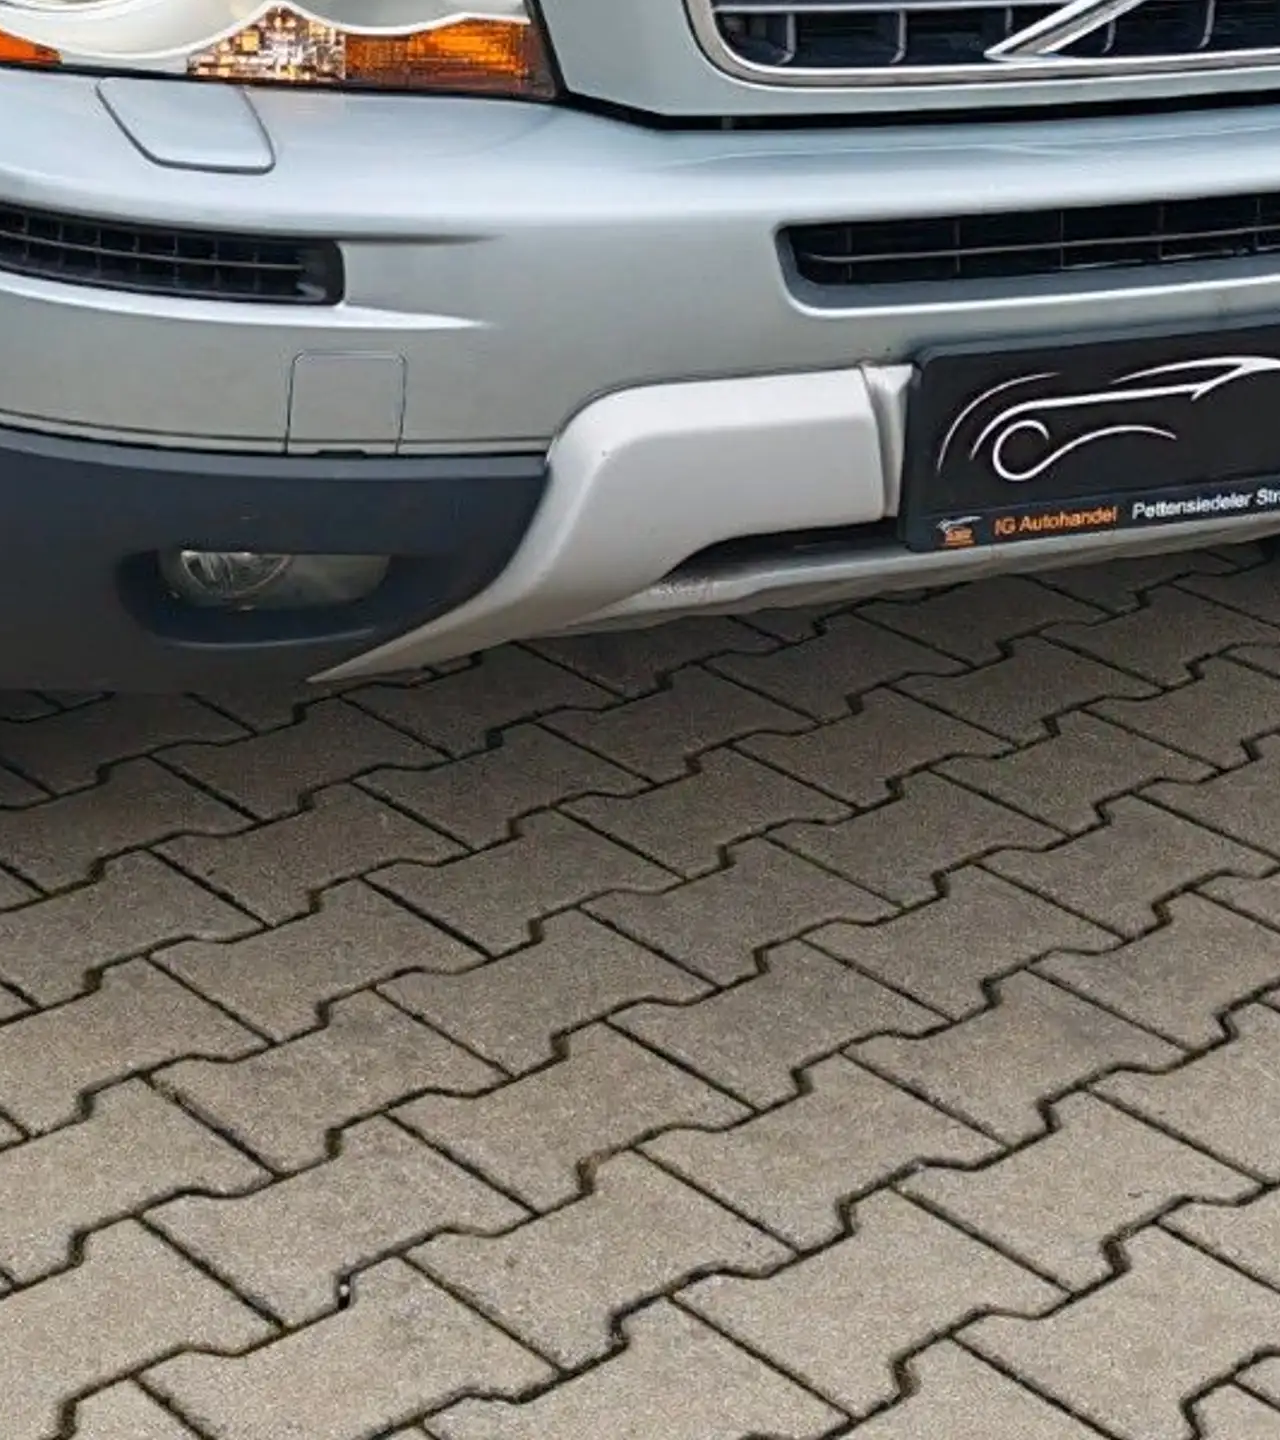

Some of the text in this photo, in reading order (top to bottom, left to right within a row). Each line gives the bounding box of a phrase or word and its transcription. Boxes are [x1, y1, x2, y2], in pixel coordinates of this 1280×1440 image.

[994, 516, 1017, 536] IG
[1019, 506, 1118, 532] Autohandel
[1131, 492, 1254, 520] Pettensiedeler
